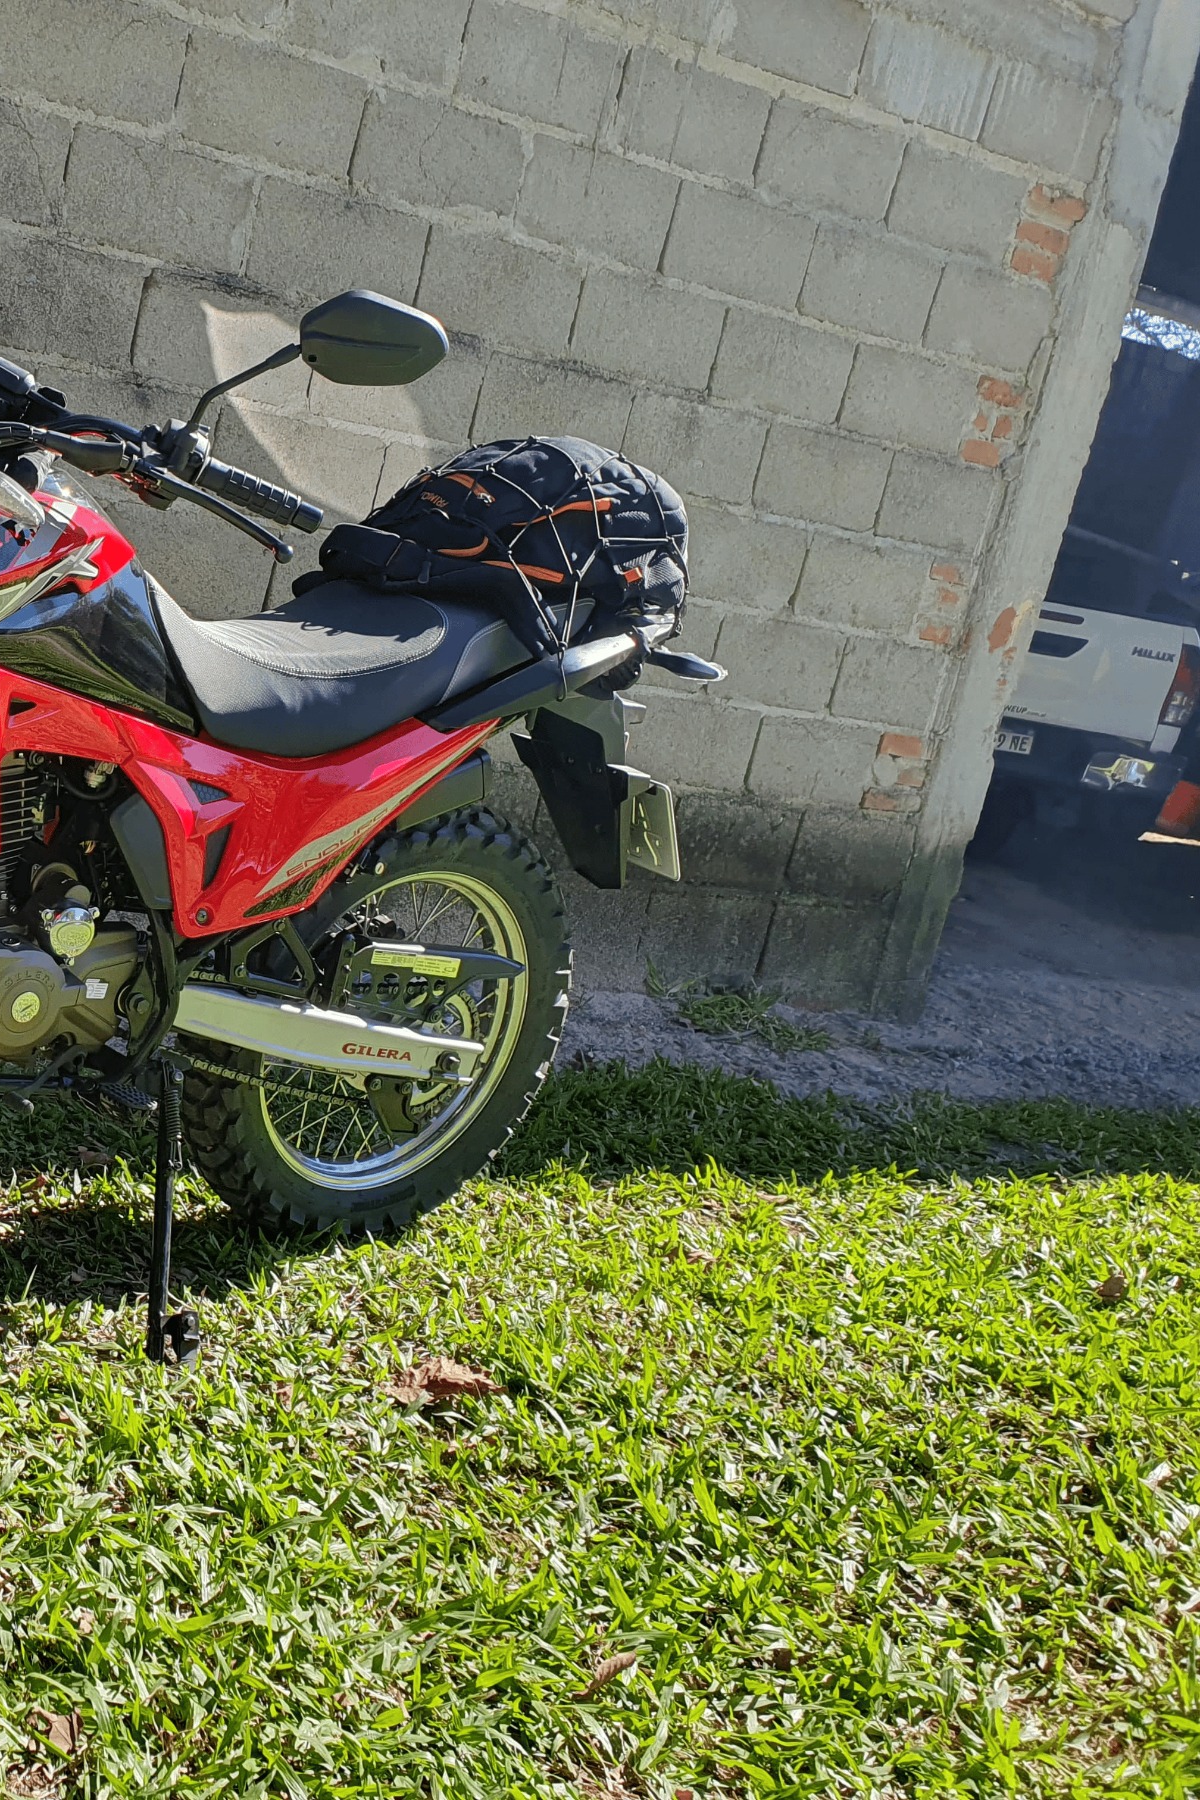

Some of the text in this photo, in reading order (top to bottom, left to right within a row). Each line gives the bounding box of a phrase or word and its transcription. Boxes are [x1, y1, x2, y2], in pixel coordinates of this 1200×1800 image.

[1131, 646, 1176, 663] HILUX
[1009, 735, 1031, 752] NE
[341, 1042, 412, 1062] GILERA
